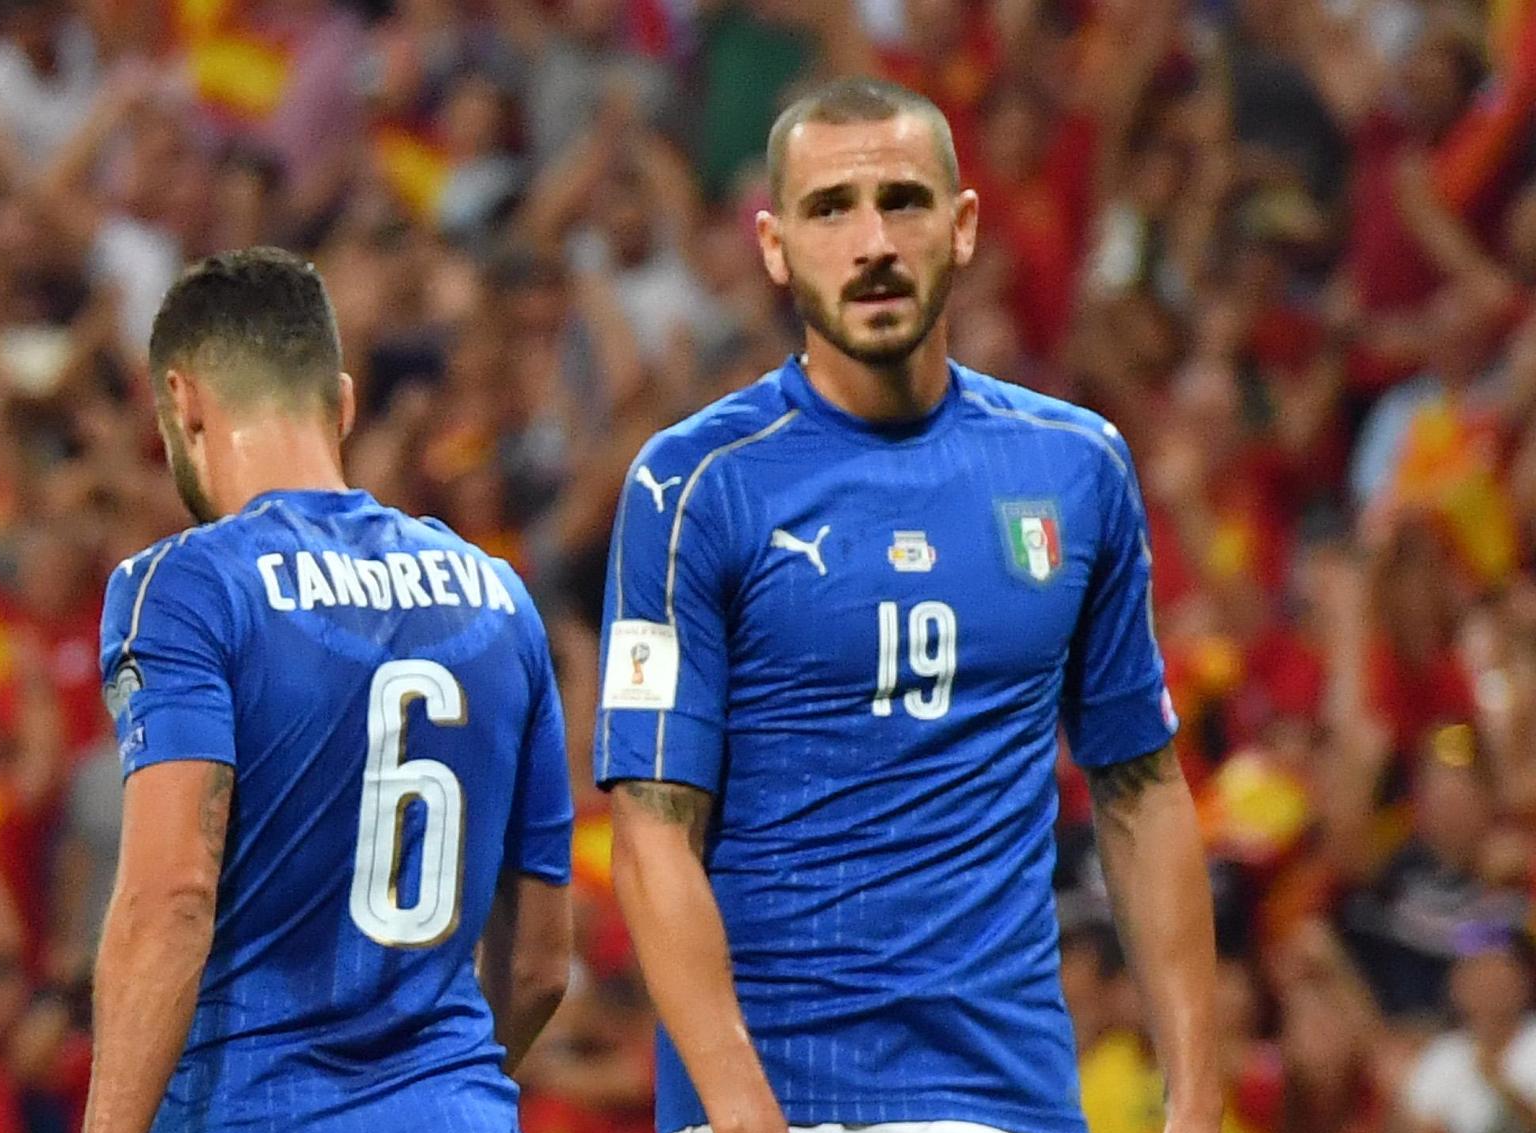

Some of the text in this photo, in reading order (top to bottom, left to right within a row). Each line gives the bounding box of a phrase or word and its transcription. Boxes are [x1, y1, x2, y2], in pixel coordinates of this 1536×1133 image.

[257, 550, 516, 614] CANDREVA
[871, 600, 956, 720] 19
[349, 659, 467, 949] 6
